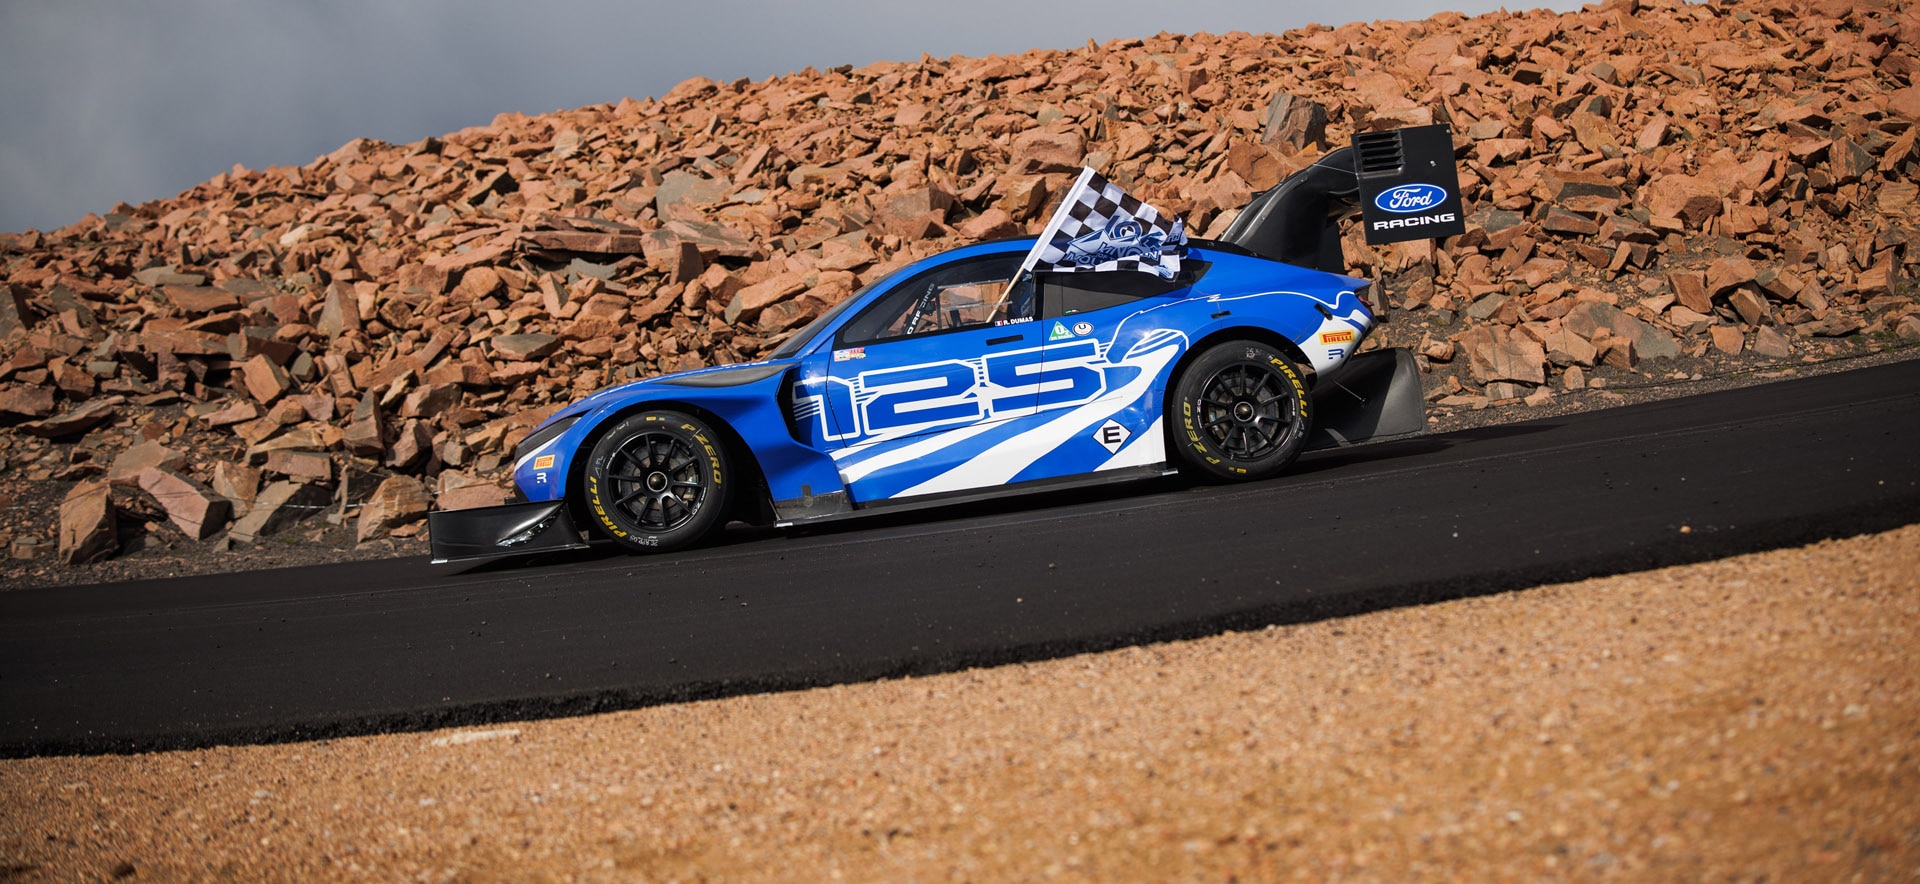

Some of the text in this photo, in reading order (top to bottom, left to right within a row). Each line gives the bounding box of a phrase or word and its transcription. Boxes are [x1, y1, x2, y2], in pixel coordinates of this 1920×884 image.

[1389, 188, 1433, 209] Ford
[1373, 213, 1455, 231] RACING
[1010, 316, 1033, 325] DUMAS
[1322, 331, 1352, 344] PIRELLI
[792, 338, 1107, 442] 125
[1270, 358, 1307, 418] PIRELLI
[1103, 425, 1122, 444] E
[1183, 401, 1221, 465] P ZERO
[681, 423, 722, 485] P ZERO
[589, 475, 628, 538] PIRELLI
